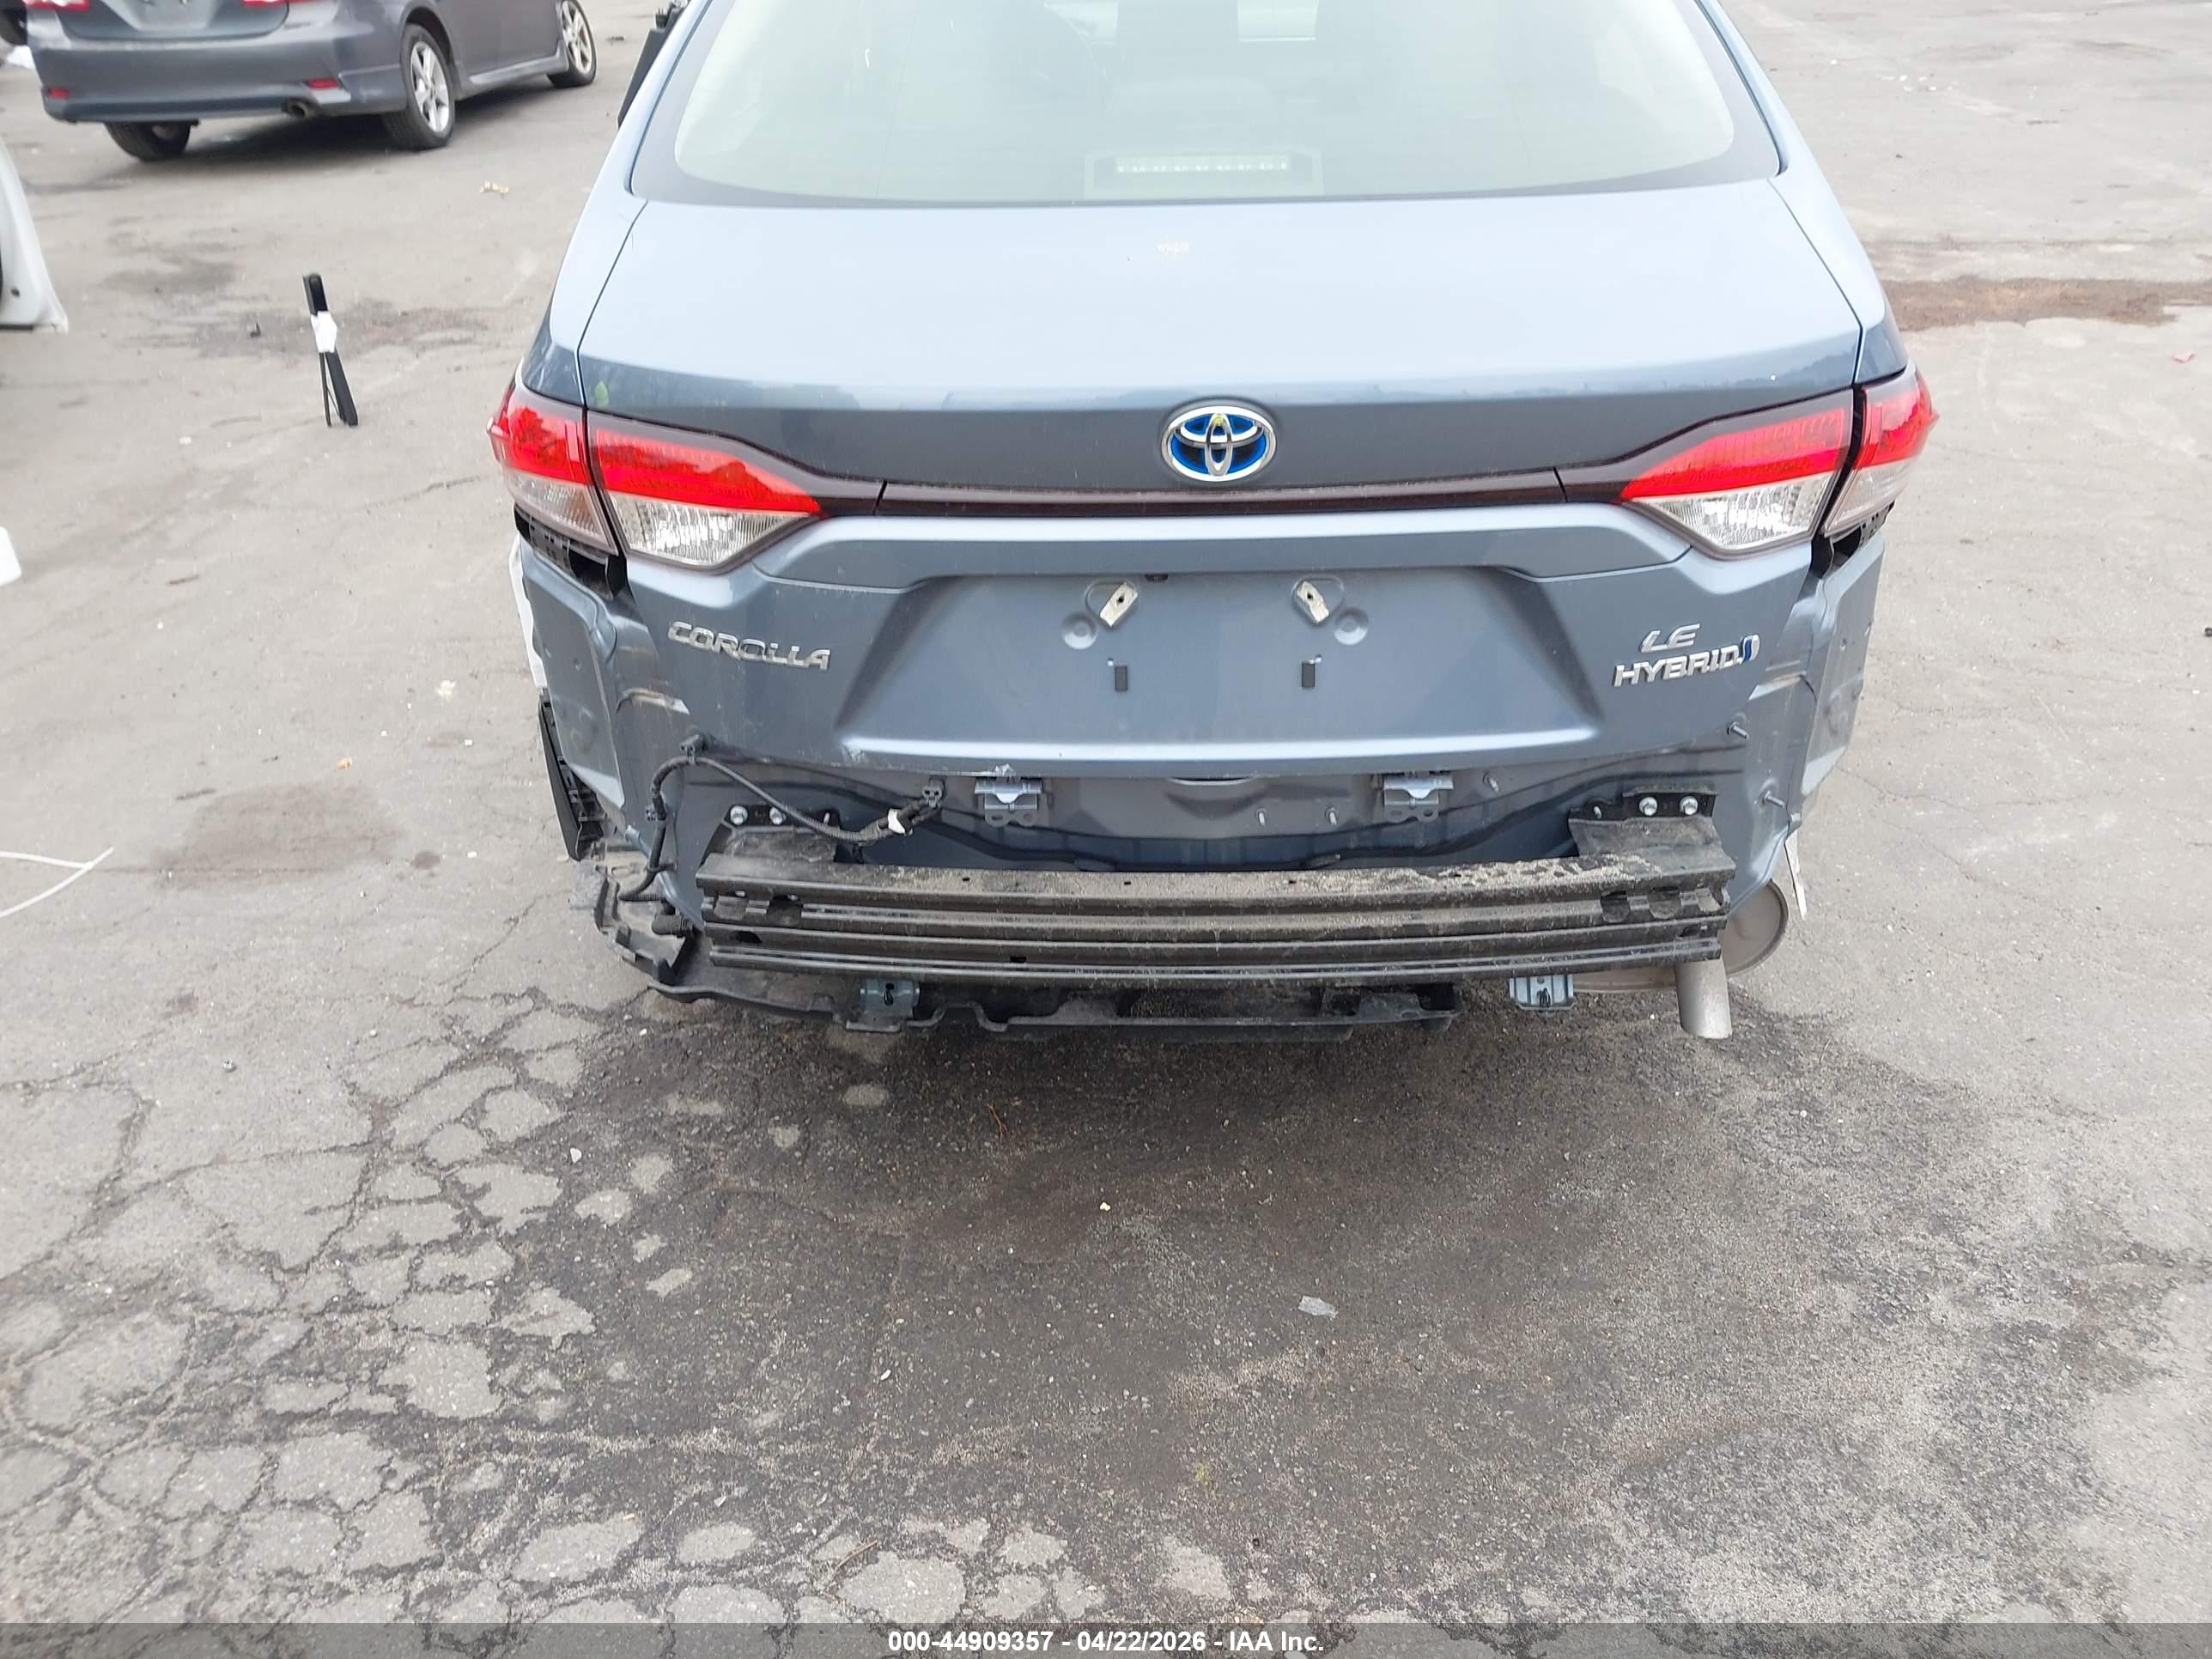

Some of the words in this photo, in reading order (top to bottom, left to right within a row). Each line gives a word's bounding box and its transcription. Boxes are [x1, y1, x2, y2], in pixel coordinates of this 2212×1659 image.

[667, 620, 831, 672] COROLLA
[1639, 623, 1701, 653] LE
[1613, 644, 1743, 688] HYBRID
